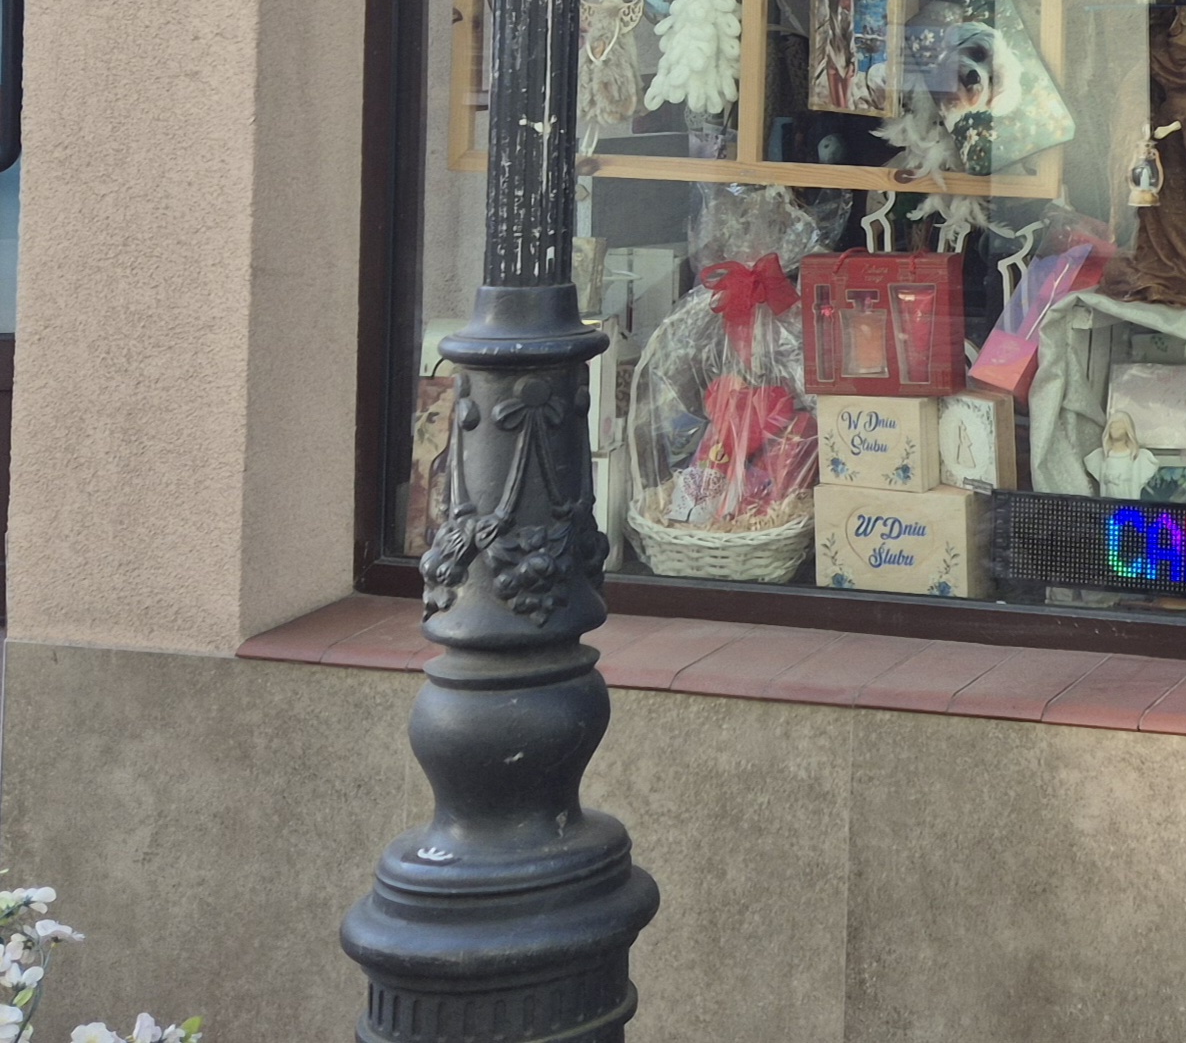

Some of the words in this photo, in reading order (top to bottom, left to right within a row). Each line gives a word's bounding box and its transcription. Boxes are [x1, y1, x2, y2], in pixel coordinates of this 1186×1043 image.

[840, 410, 864, 430] W
[863, 410, 897, 431] Dniu
[850, 432, 889, 456] Ślubu
[854, 514, 883, 538] W
[881, 517, 928, 540] Dniu
[868, 542, 916, 569] Ślubu
